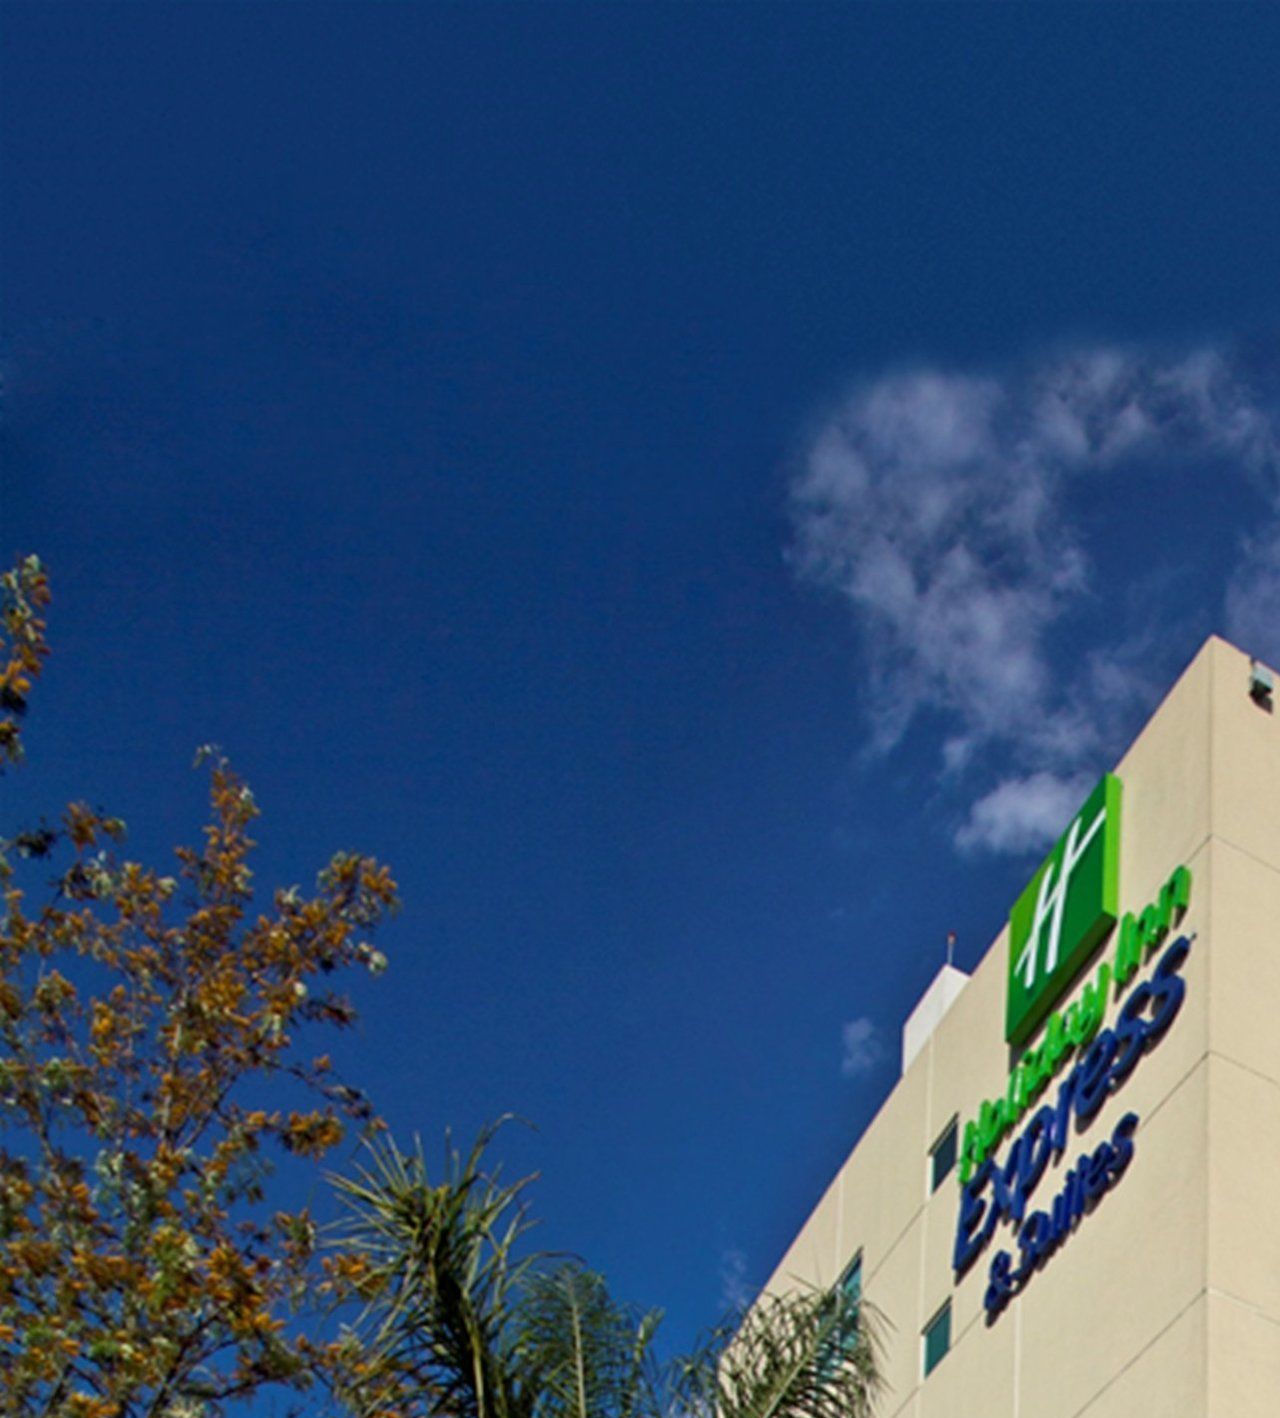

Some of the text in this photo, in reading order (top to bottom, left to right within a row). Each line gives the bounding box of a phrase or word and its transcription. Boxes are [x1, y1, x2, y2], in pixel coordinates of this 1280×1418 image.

[953, 935, 1188, 1280] Express
[959, 864, 1191, 1184] Holiday Inn
[984, 1112, 1140, 1322] & Suites
